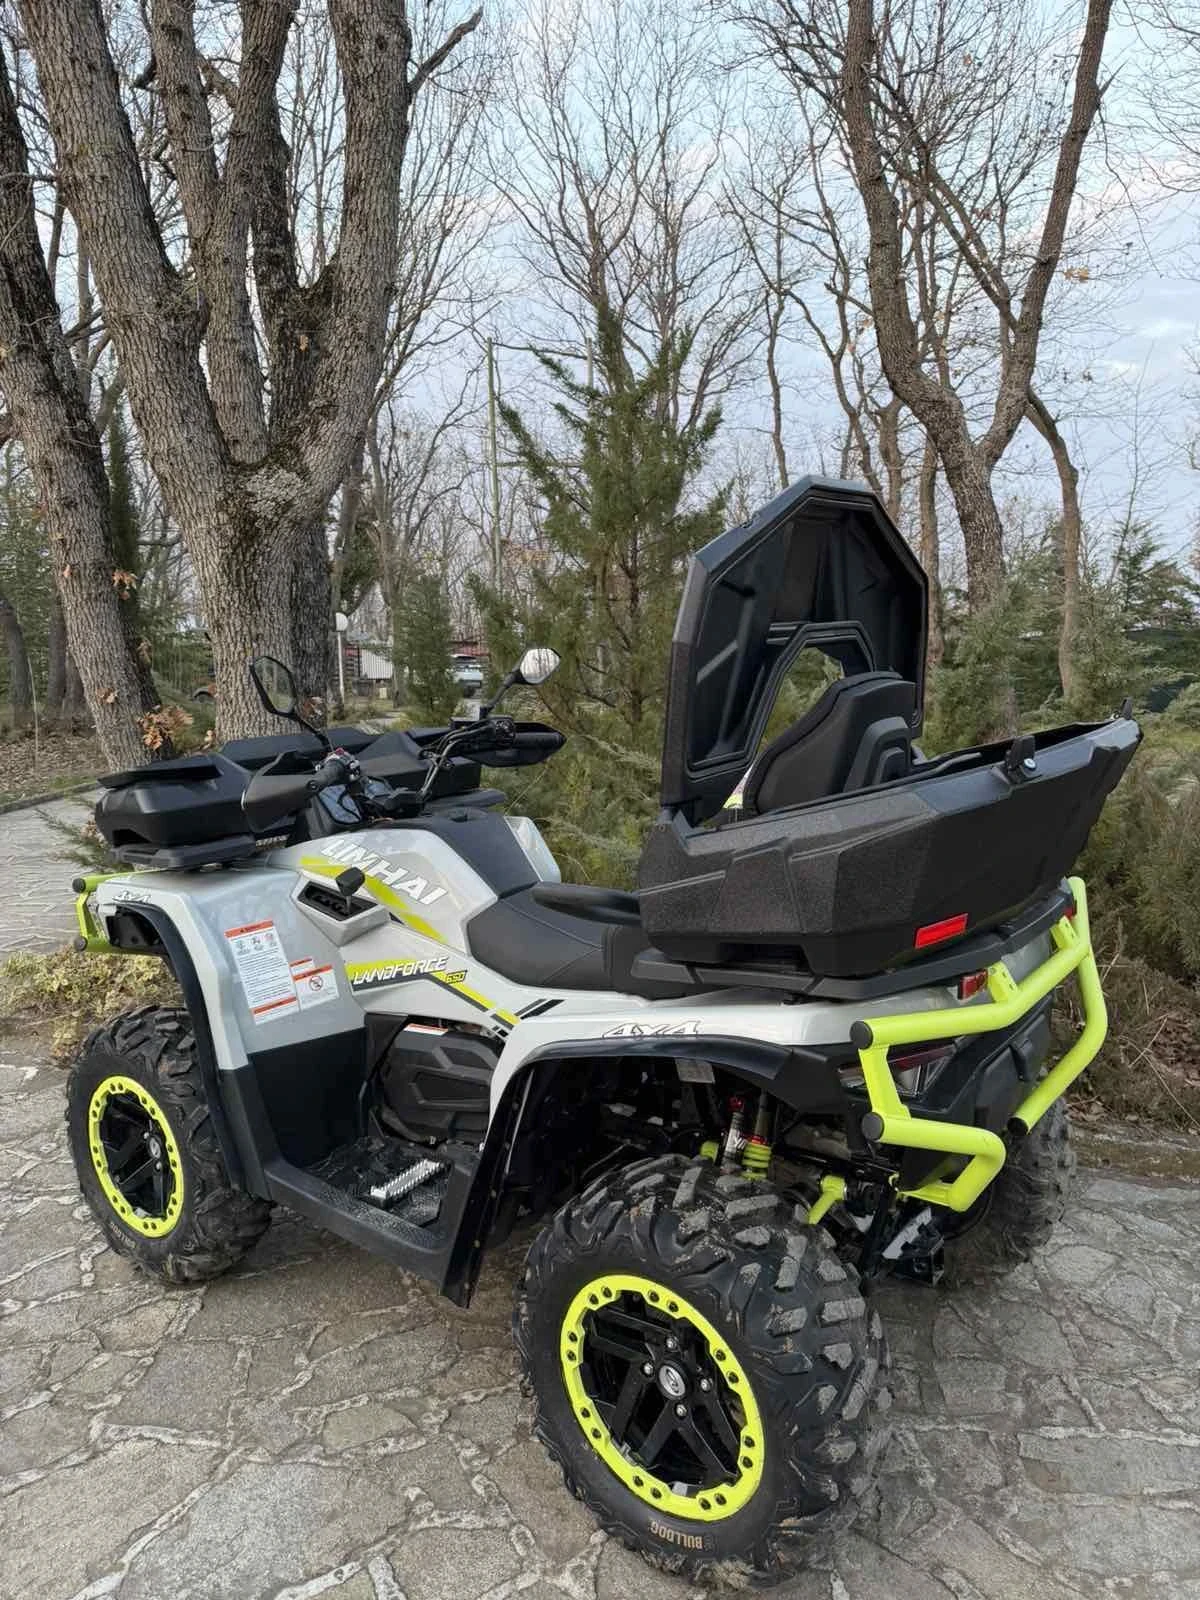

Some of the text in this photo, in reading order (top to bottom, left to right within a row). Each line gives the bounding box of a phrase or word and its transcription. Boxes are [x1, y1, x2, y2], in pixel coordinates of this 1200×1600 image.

[320, 839, 448, 904] LINHAI
[352, 956, 449, 985] LANDFORCE
[650, 1521, 702, 1549] BULLDOG
